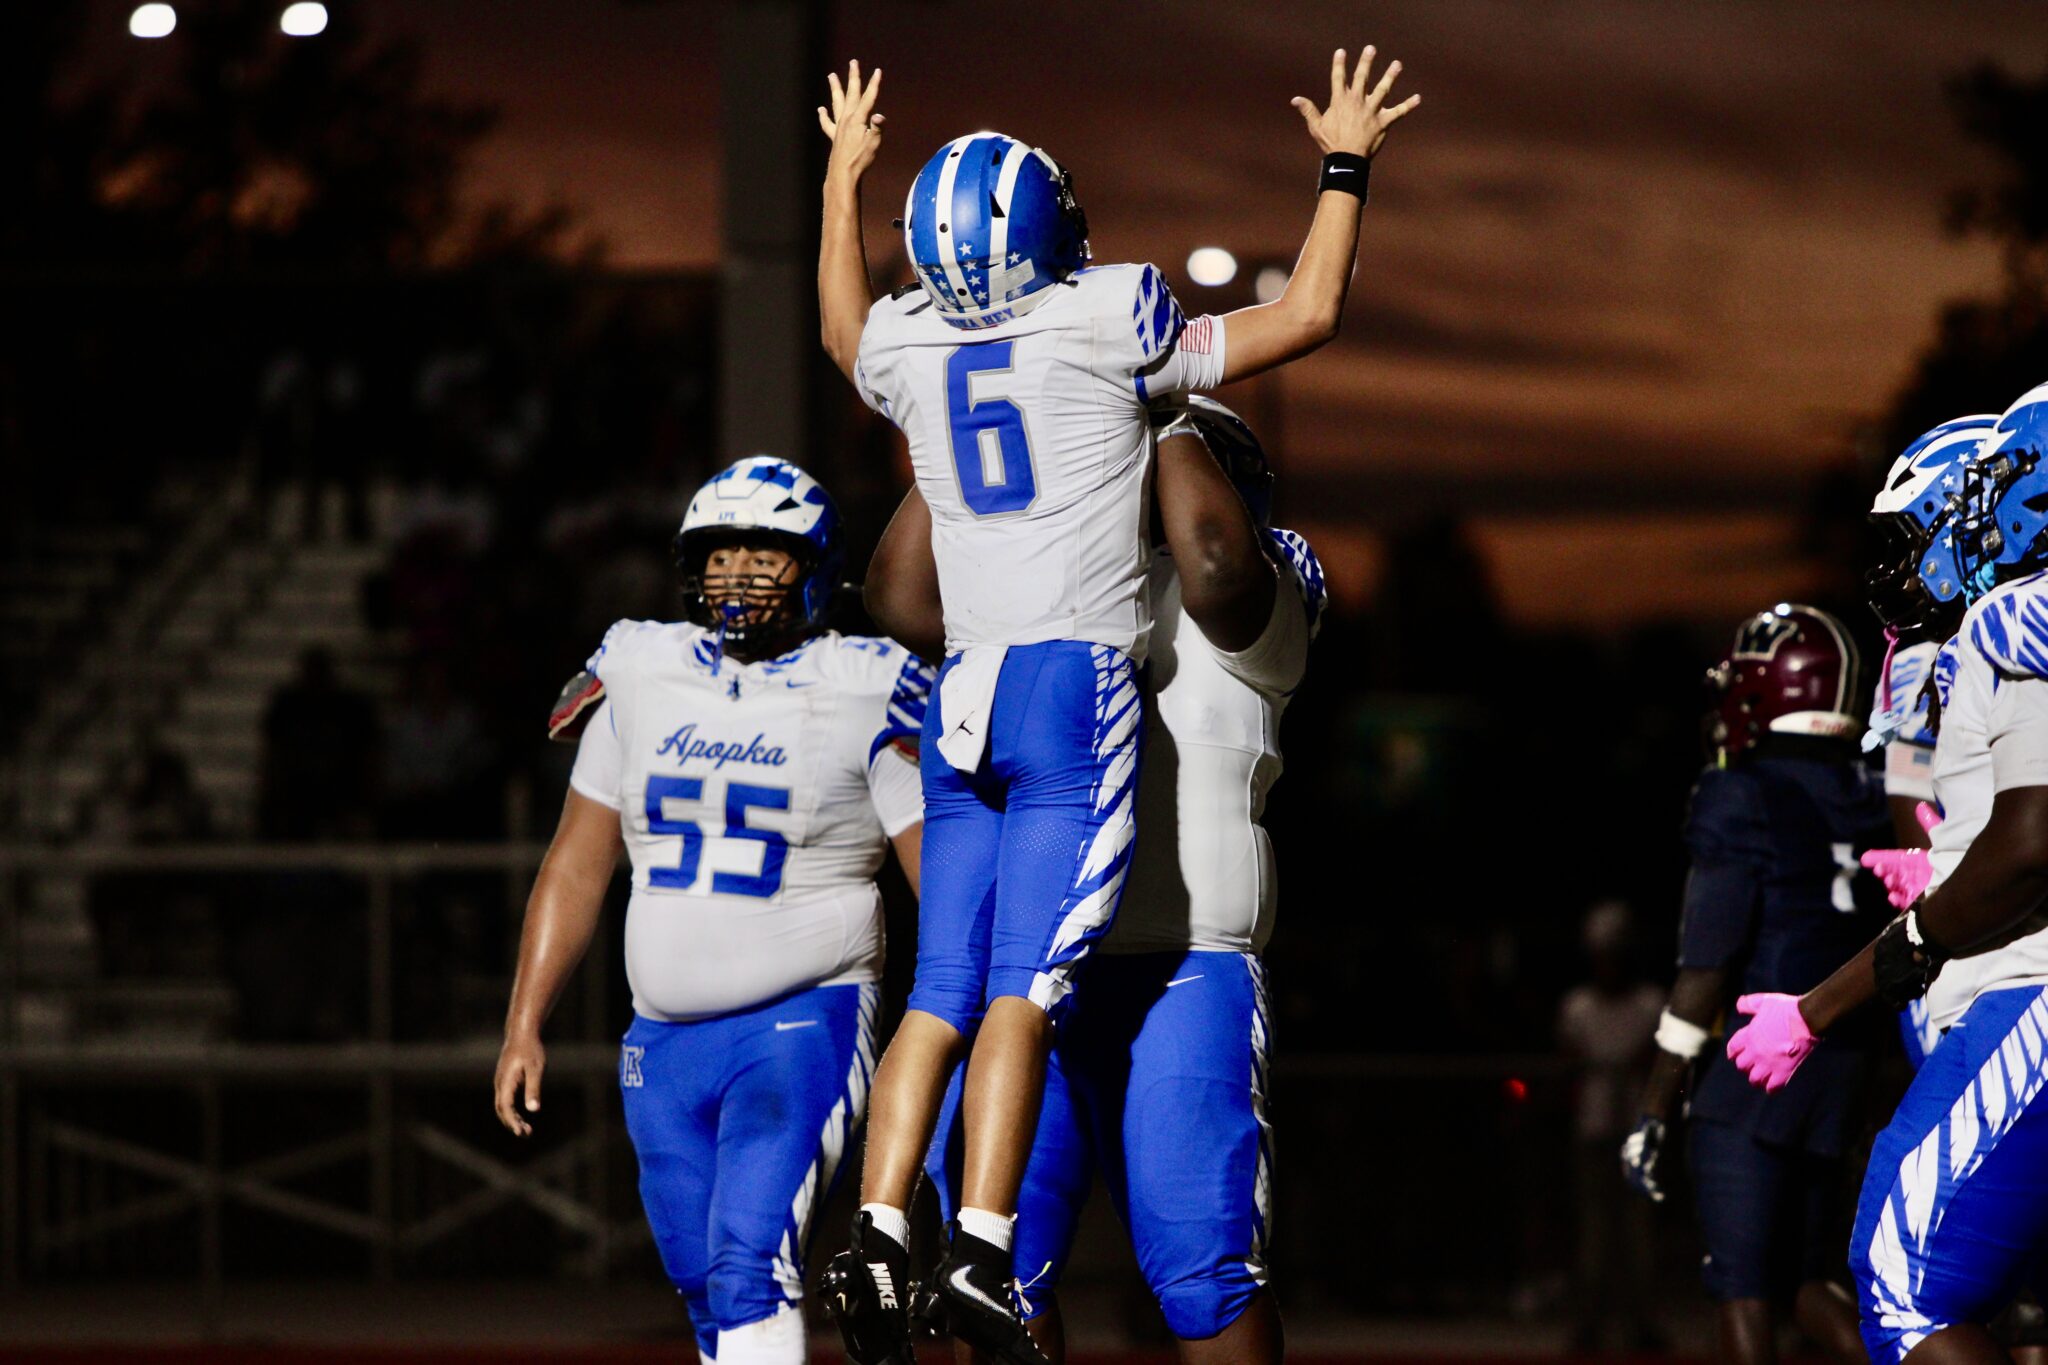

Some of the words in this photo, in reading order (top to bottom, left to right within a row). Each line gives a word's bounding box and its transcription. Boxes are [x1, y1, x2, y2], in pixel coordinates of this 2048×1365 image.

[981, 307, 1016, 326] HEY
[943, 339, 1042, 521] 6
[656, 723, 787, 770] Apopka
[643, 772, 793, 900] 55
[866, 1262, 899, 1310] NIKE
